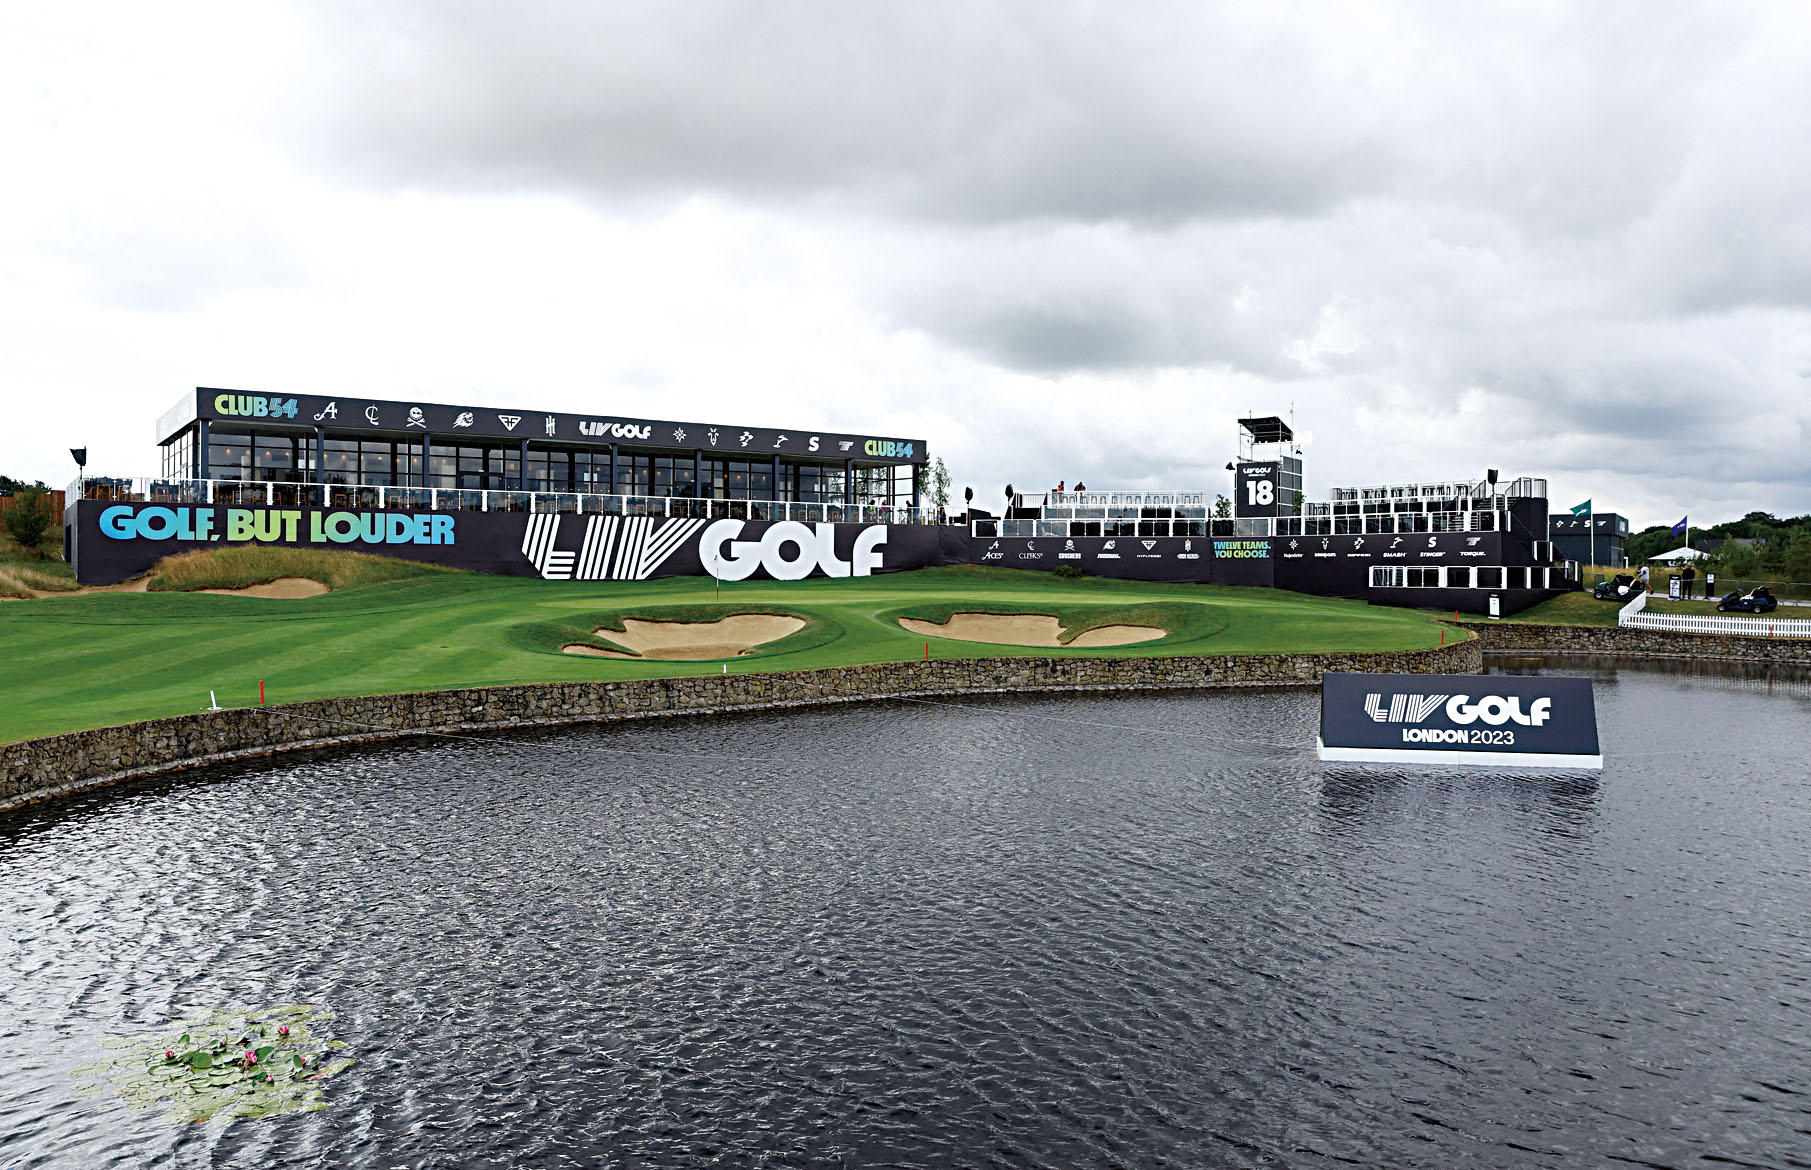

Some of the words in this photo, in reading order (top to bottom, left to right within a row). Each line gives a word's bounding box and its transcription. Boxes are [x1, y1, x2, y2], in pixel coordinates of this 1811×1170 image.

[1246, 480, 1274, 506] 18
[99, 505, 220, 542] GOLF,
[227, 509, 302, 542] BUT
[310, 510, 455, 545] LOUDER
[1213, 541, 1241, 551] TWELVE
[1242, 541, 1272, 551] TEAMS.
[1214, 550, 1233, 559] YOU
[1233, 550, 1270, 560] CHOOSE.
[1402, 728, 1469, 744] LONDON
[1470, 729, 1515, 745] 2023
